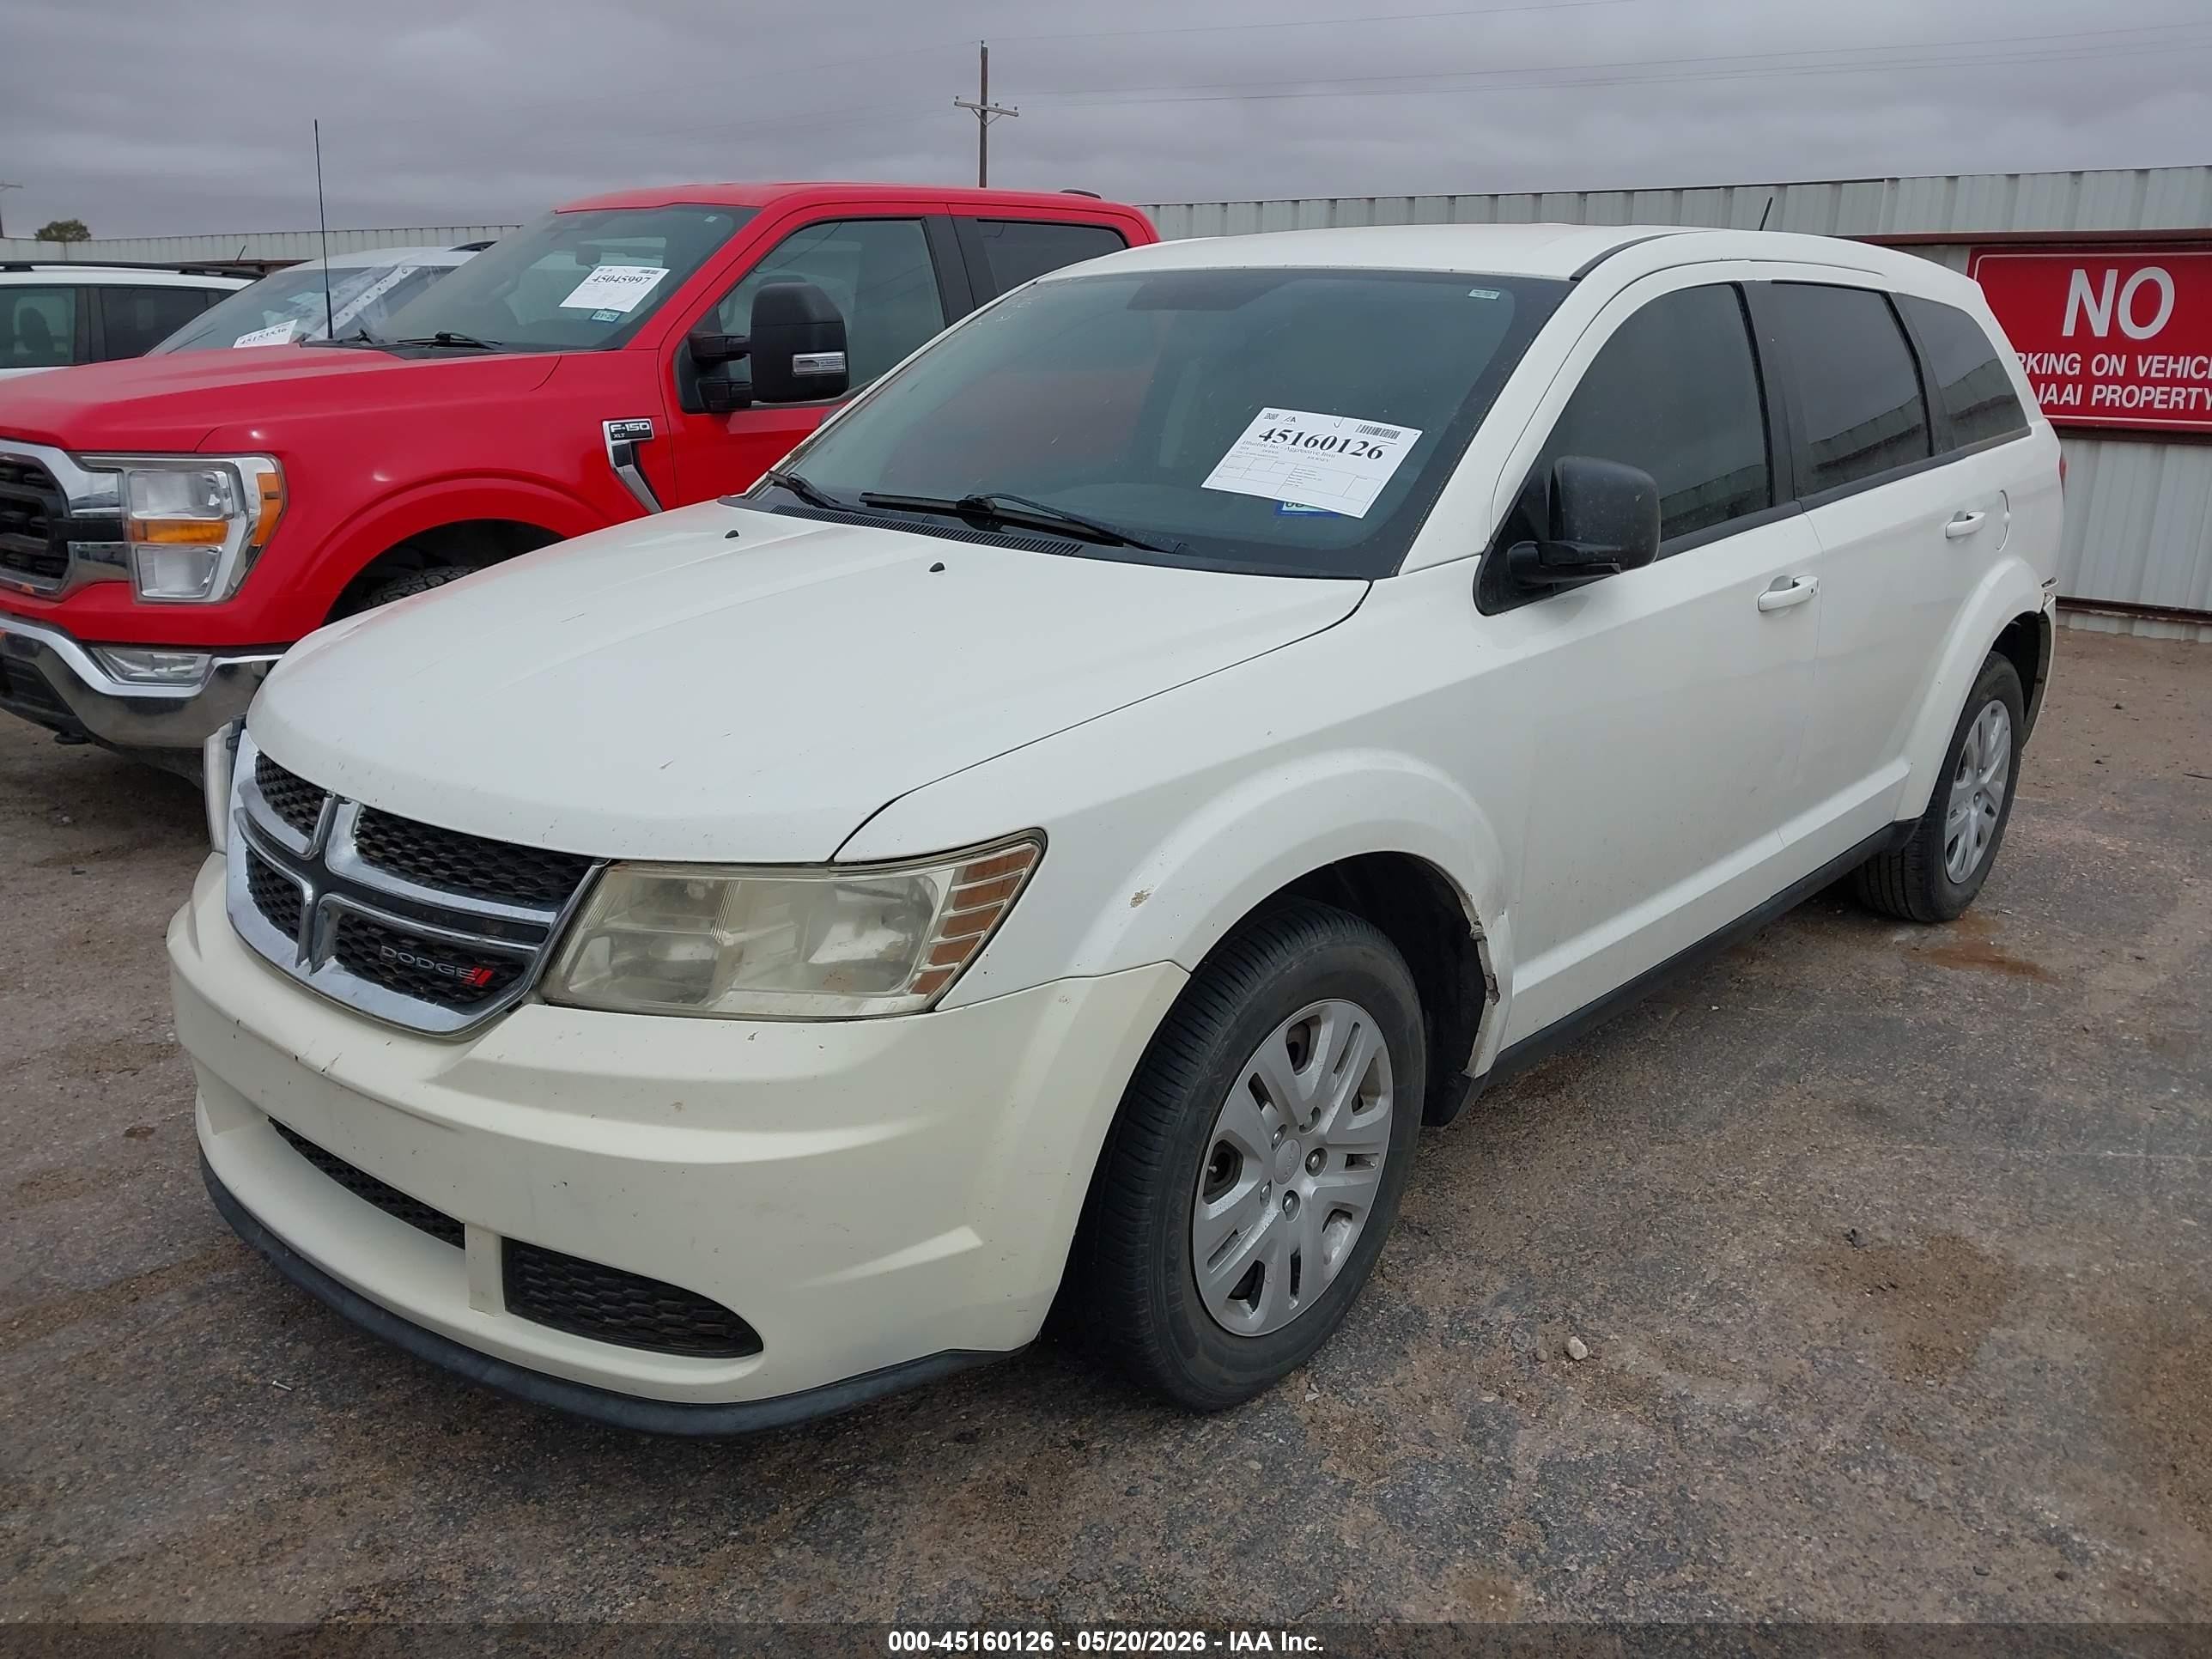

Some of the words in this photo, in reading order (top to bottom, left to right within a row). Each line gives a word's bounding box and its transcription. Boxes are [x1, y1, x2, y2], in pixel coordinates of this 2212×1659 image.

[591, 274, 653, 285] 45045997
[2062, 266, 2175, 340] NO
[2091, 353, 2126, 377] ON
[2038, 382, 2083, 405] IAAI
[610, 422, 650, 433] F-150
[1258, 427, 1389, 460] 45160126
[380, 945, 476, 981] DODGE
